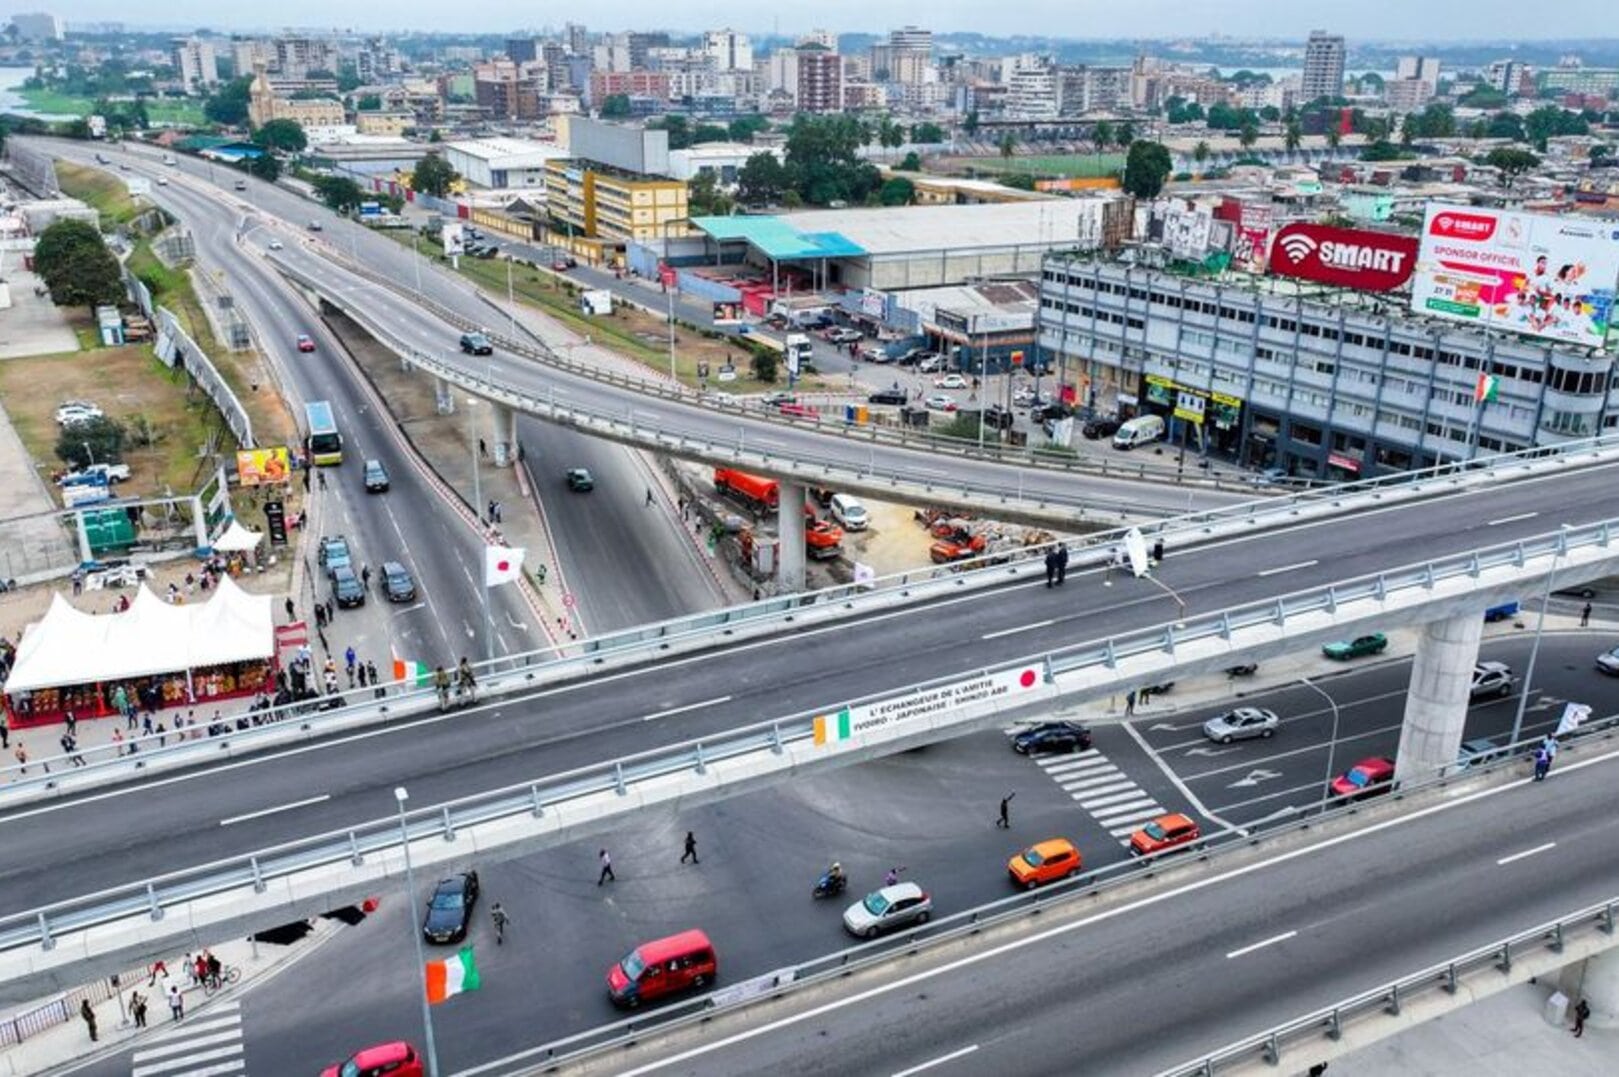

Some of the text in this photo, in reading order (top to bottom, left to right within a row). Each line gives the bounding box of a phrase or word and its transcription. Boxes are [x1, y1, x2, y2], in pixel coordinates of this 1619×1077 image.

[1454, 219, 1491, 232] SMART
[1318, 239, 1406, 274] SMART
[1433, 245, 1521, 267] SPONSOR OFFICIEL
[940, 689, 953, 699] DE
[895, 702, 946, 721] JAPONAISE
[954, 691, 989, 705] SHINZO
